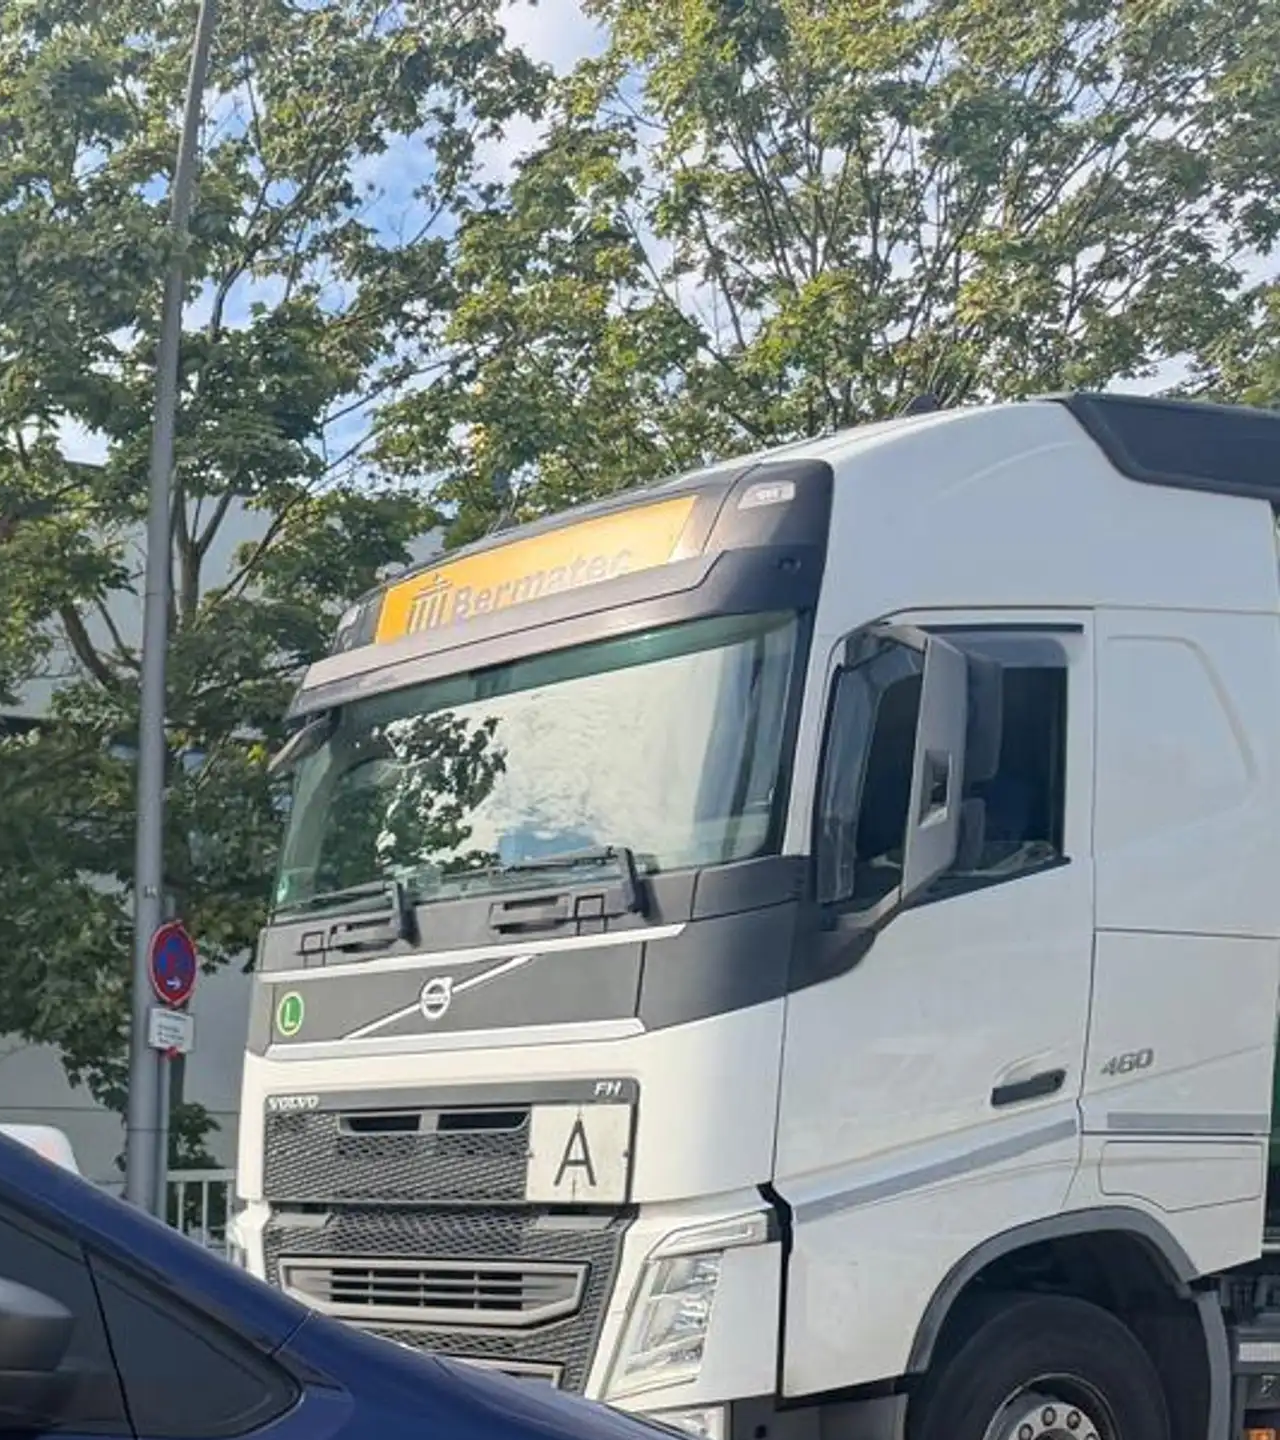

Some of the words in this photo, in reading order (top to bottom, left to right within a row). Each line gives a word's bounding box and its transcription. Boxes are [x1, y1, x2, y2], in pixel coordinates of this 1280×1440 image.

[452, 547, 634, 618] Bermatec
[284, 1001, 297, 1028] L
[1100, 1048, 1154, 1075] 460
[594, 1080, 622, 1096] FH
[268, 1095, 319, 1110] VOLVO
[553, 1120, 597, 1187] A
